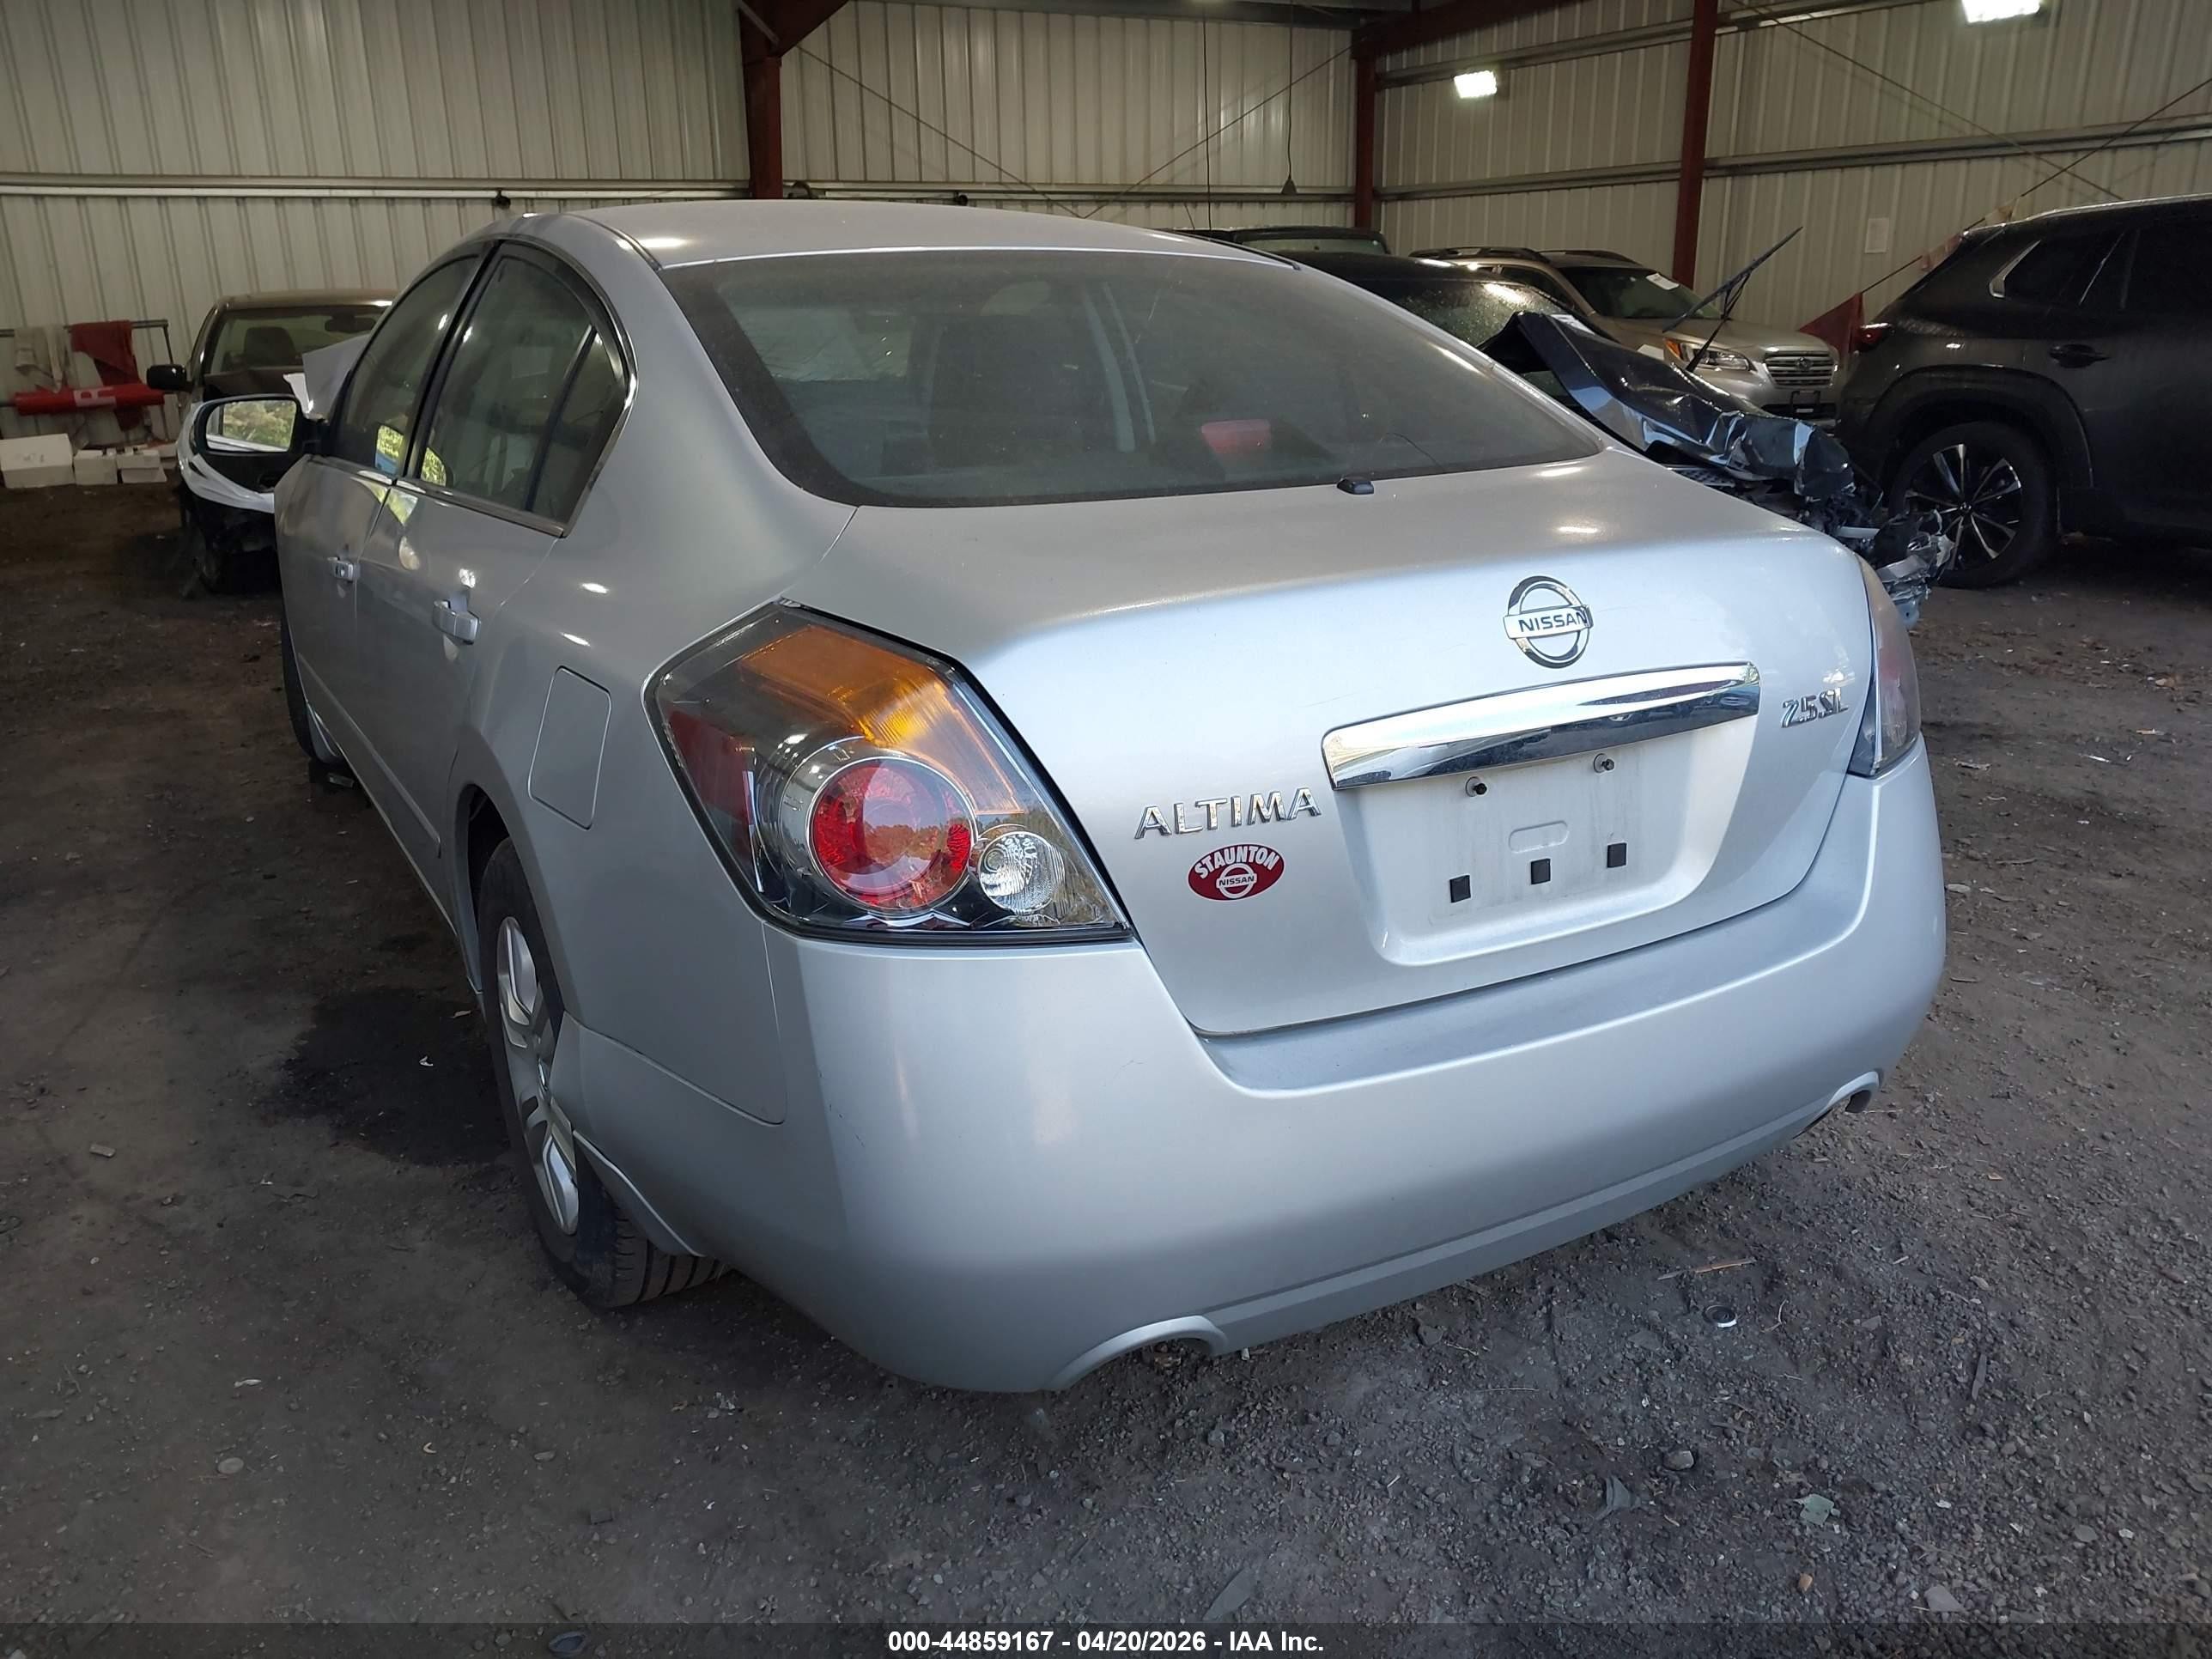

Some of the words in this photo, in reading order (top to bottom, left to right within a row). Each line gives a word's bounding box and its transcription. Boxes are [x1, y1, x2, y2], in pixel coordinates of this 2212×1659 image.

[1518, 611, 1588, 632] NISSAN
[1133, 787, 1322, 839] ALTIMA
[1194, 846, 1280, 878] STAUNTON
[1218, 875, 1255, 886] NISSAN
